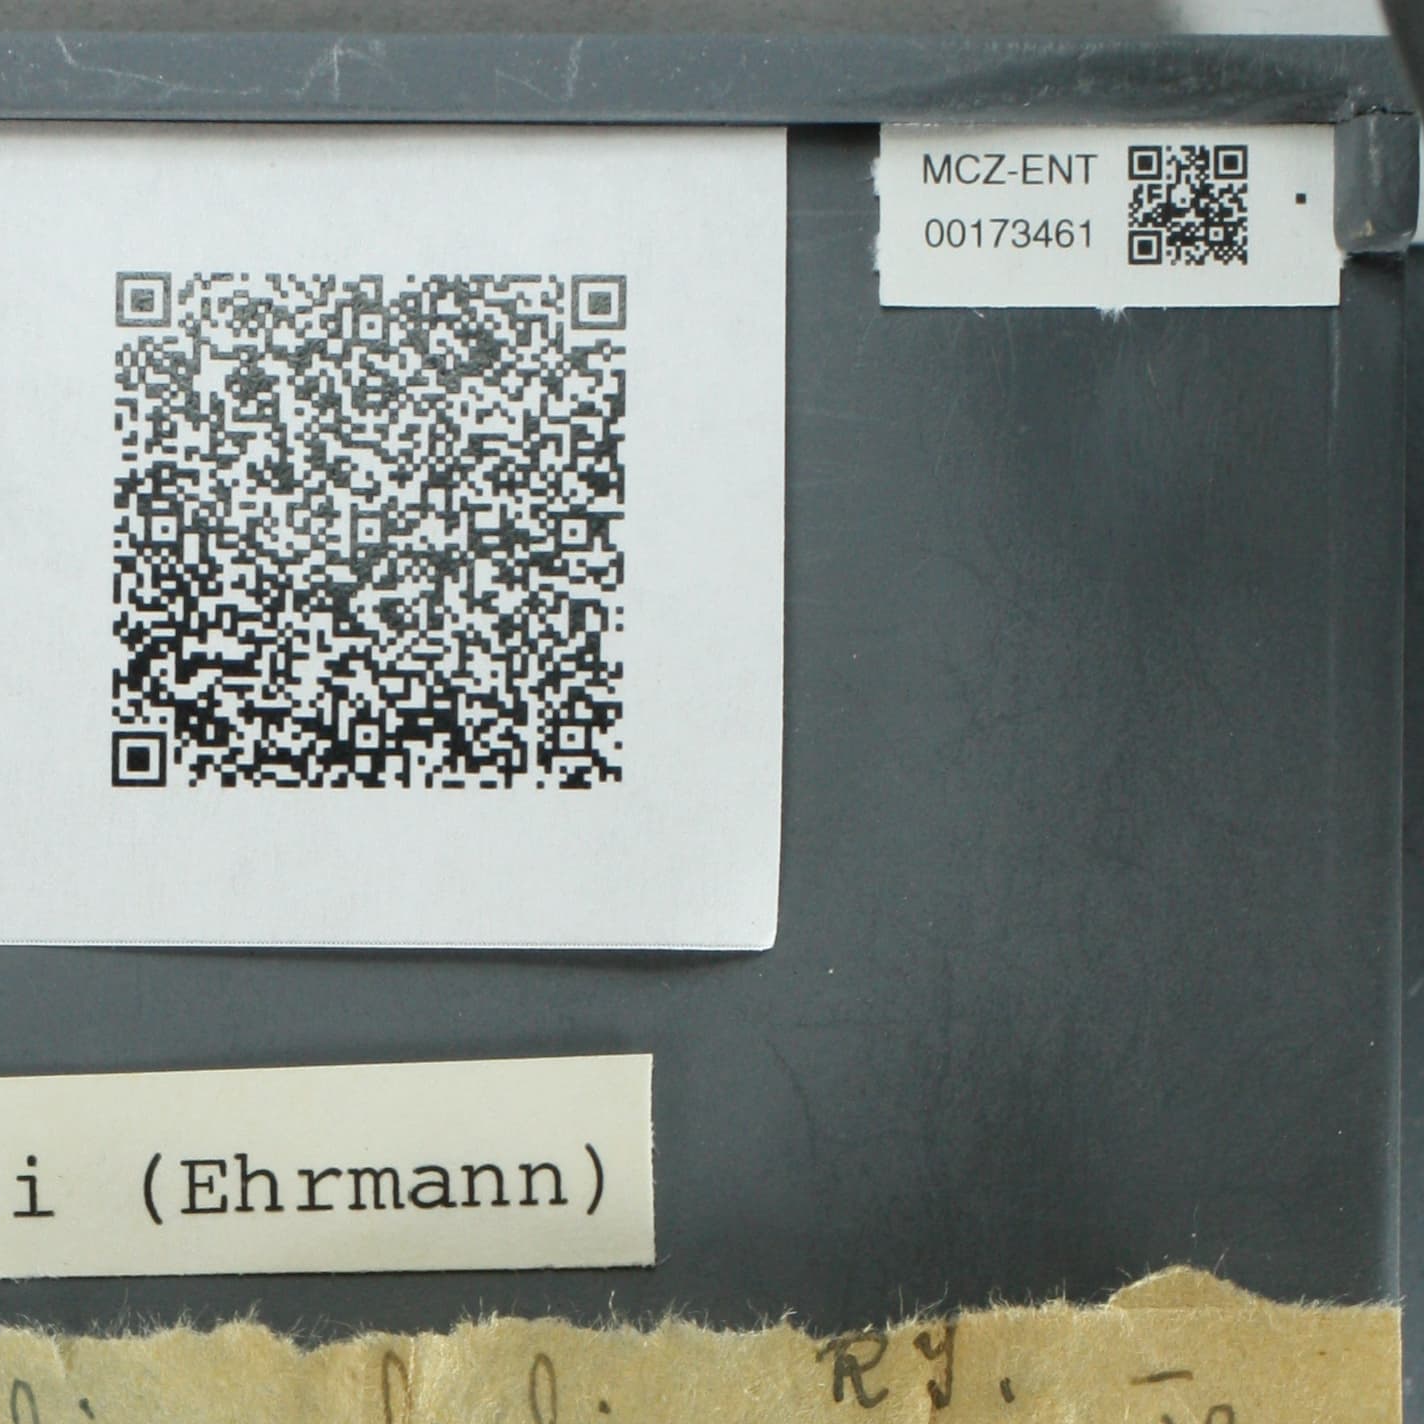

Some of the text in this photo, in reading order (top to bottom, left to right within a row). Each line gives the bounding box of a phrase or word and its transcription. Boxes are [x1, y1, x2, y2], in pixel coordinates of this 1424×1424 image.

[922, 153, 1099, 185] MCZ-ENT
[924, 218, 1092, 249] 00173461
[141, 1143, 606, 1226] (Ehrmann)
